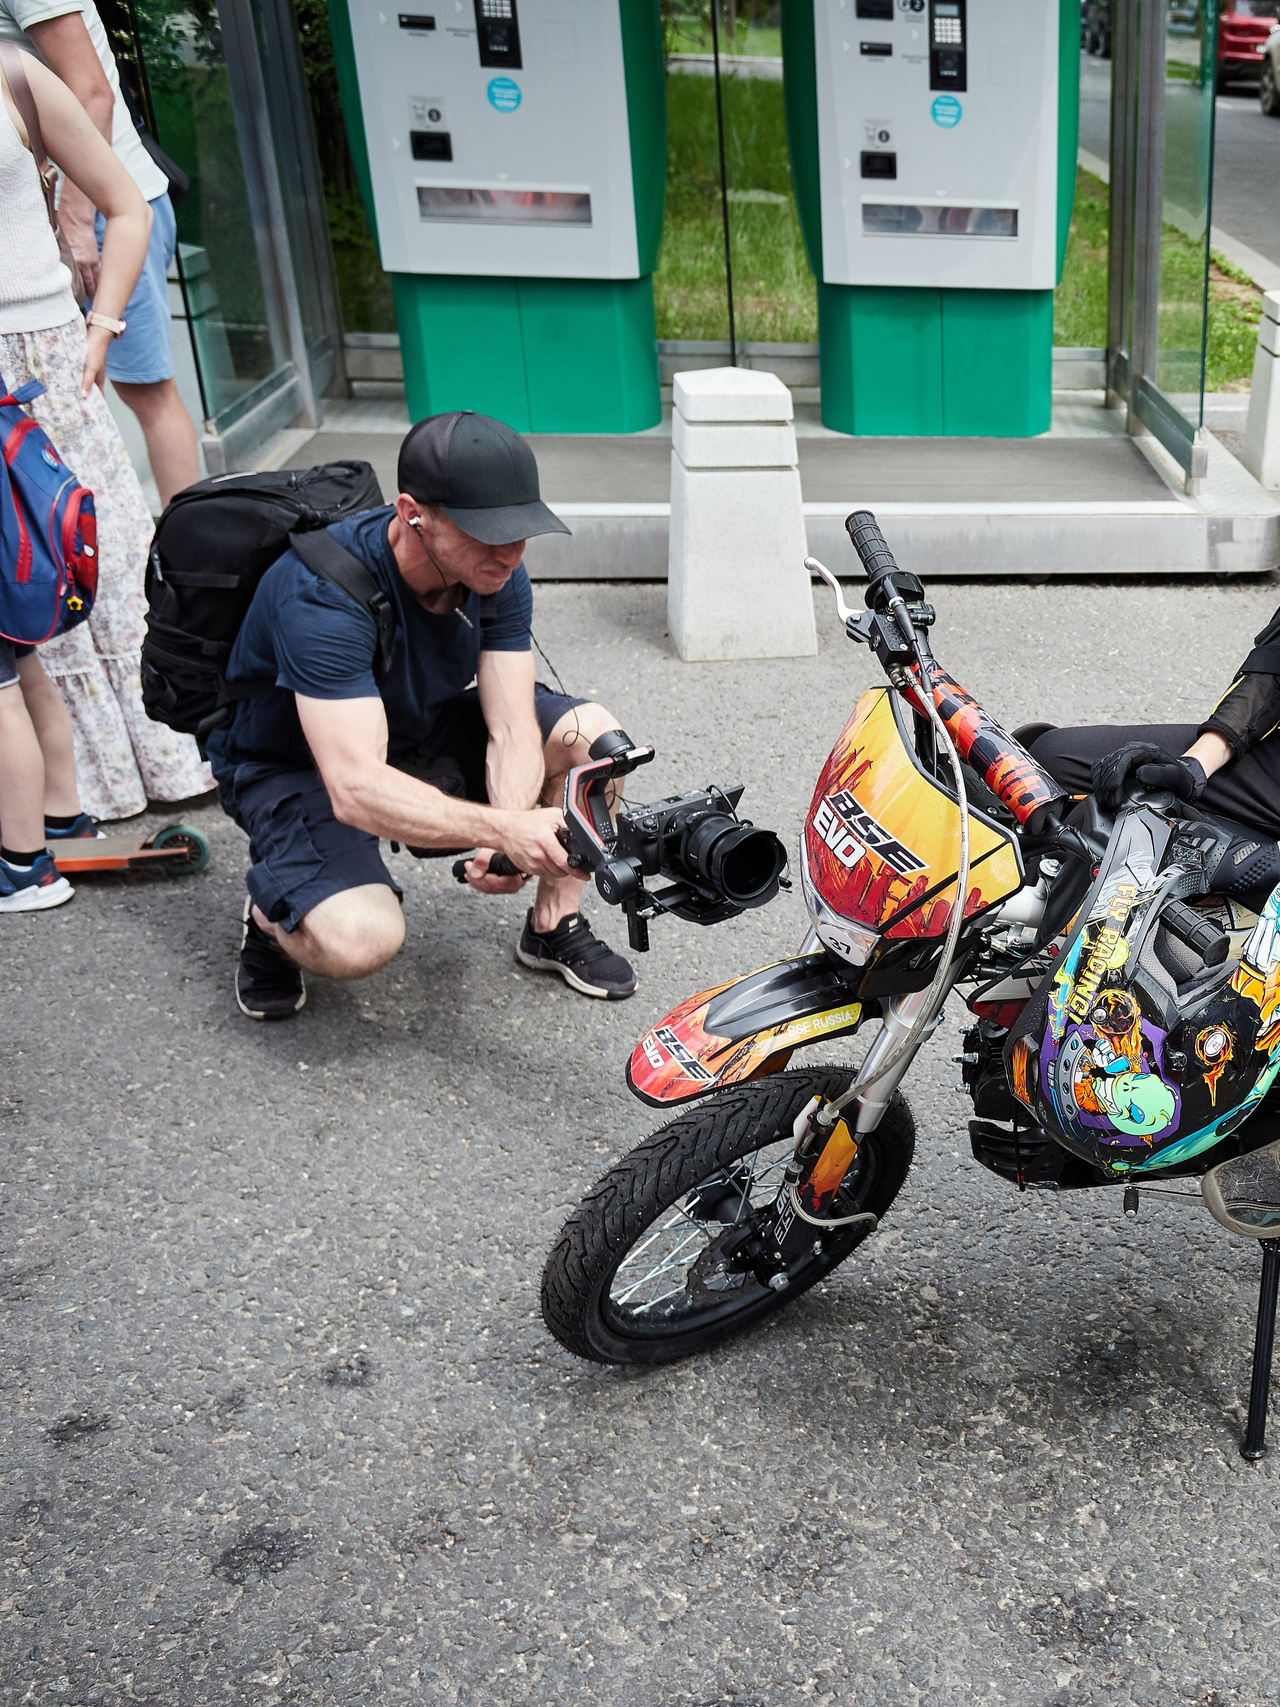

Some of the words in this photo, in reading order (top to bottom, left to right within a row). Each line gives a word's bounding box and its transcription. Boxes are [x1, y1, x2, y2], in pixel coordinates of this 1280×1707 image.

[812, 799, 867, 868] EVO
[825, 789, 931, 875] BSE
[1107, 883, 1136, 922] FLY
[828, 936, 852, 956] 37
[788, 1020, 812, 1037] BSE
[812, 1009, 853, 1031] RUSSIA
[641, 1033, 665, 1069] EVO
[652, 1026, 716, 1080] BSE
